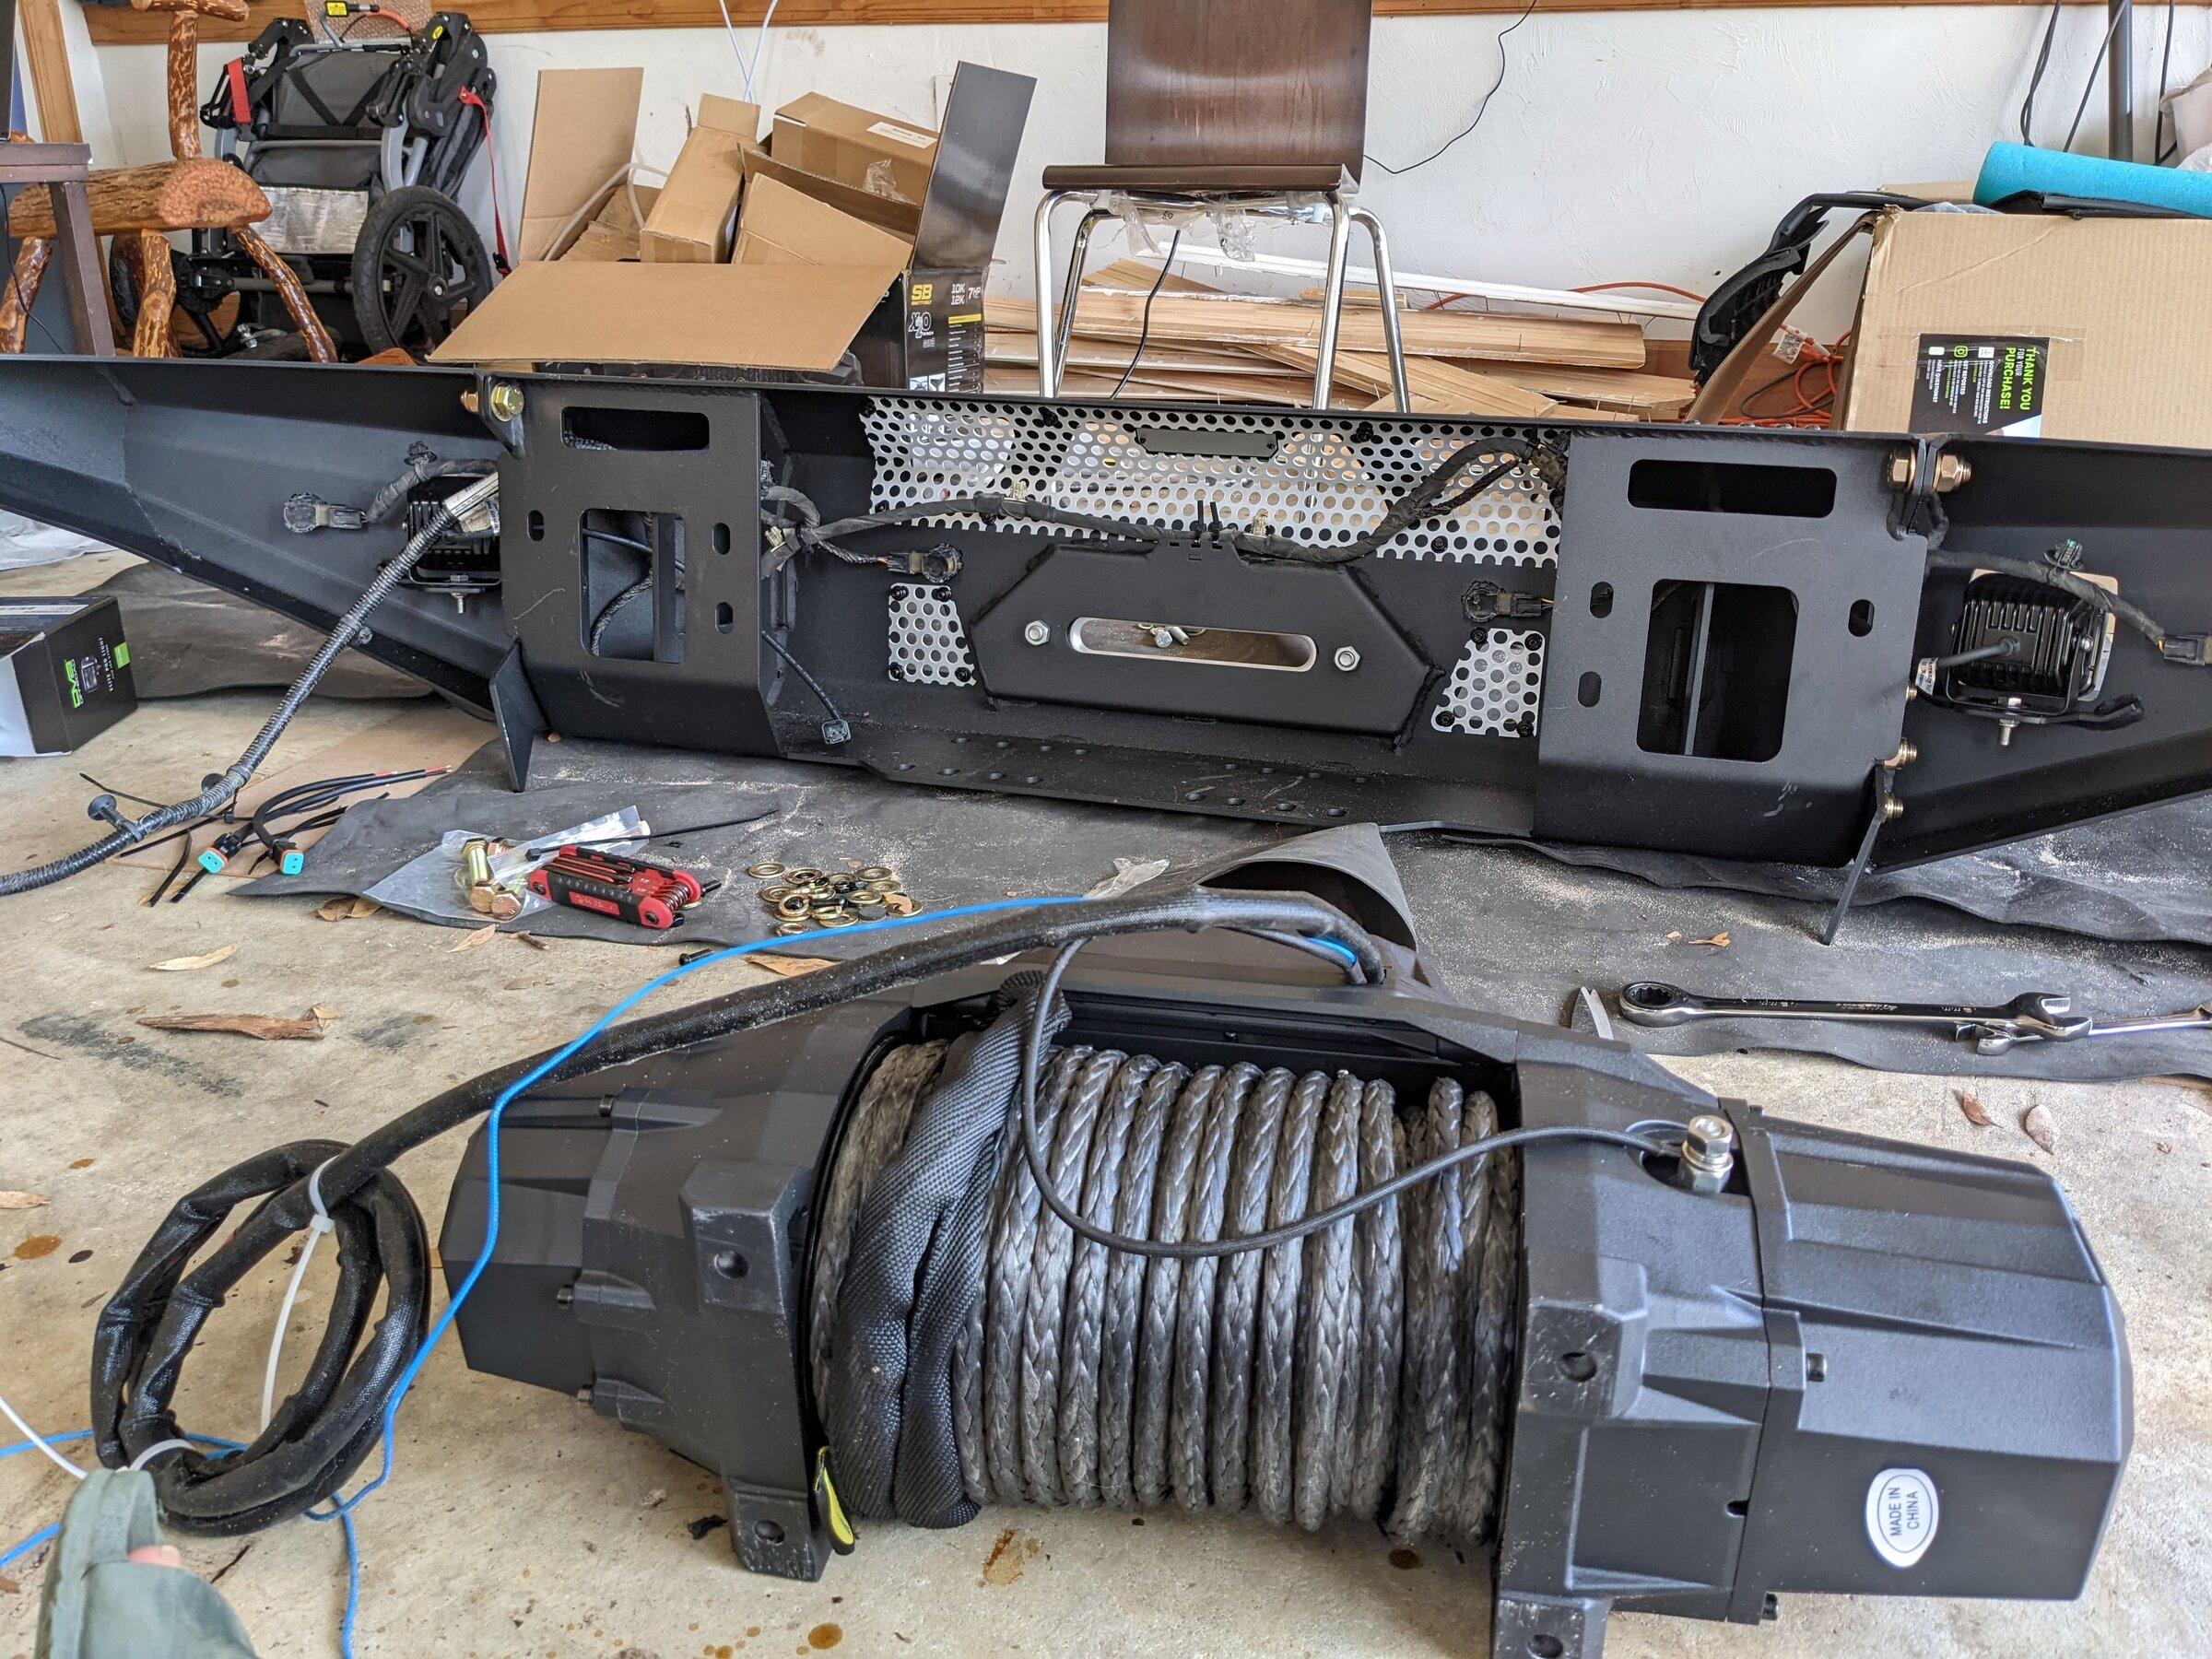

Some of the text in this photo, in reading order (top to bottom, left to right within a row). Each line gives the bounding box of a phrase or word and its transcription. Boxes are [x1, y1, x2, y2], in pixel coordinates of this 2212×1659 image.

[912, 284, 933, 300] SB
[950, 295, 965, 305] 12K
[951, 283, 966, 294] 10K
[1999, 347, 2017, 410] PURCHASE!
[2015, 348, 2025, 376] FOR YOUR
[2019, 347, 2037, 410] THANK YOU
[1983, 389, 1991, 424] INSTRUCTIONS
[1888, 1487, 1902, 1536] MADE IN
[1906, 1490, 1920, 1530] CHINA
